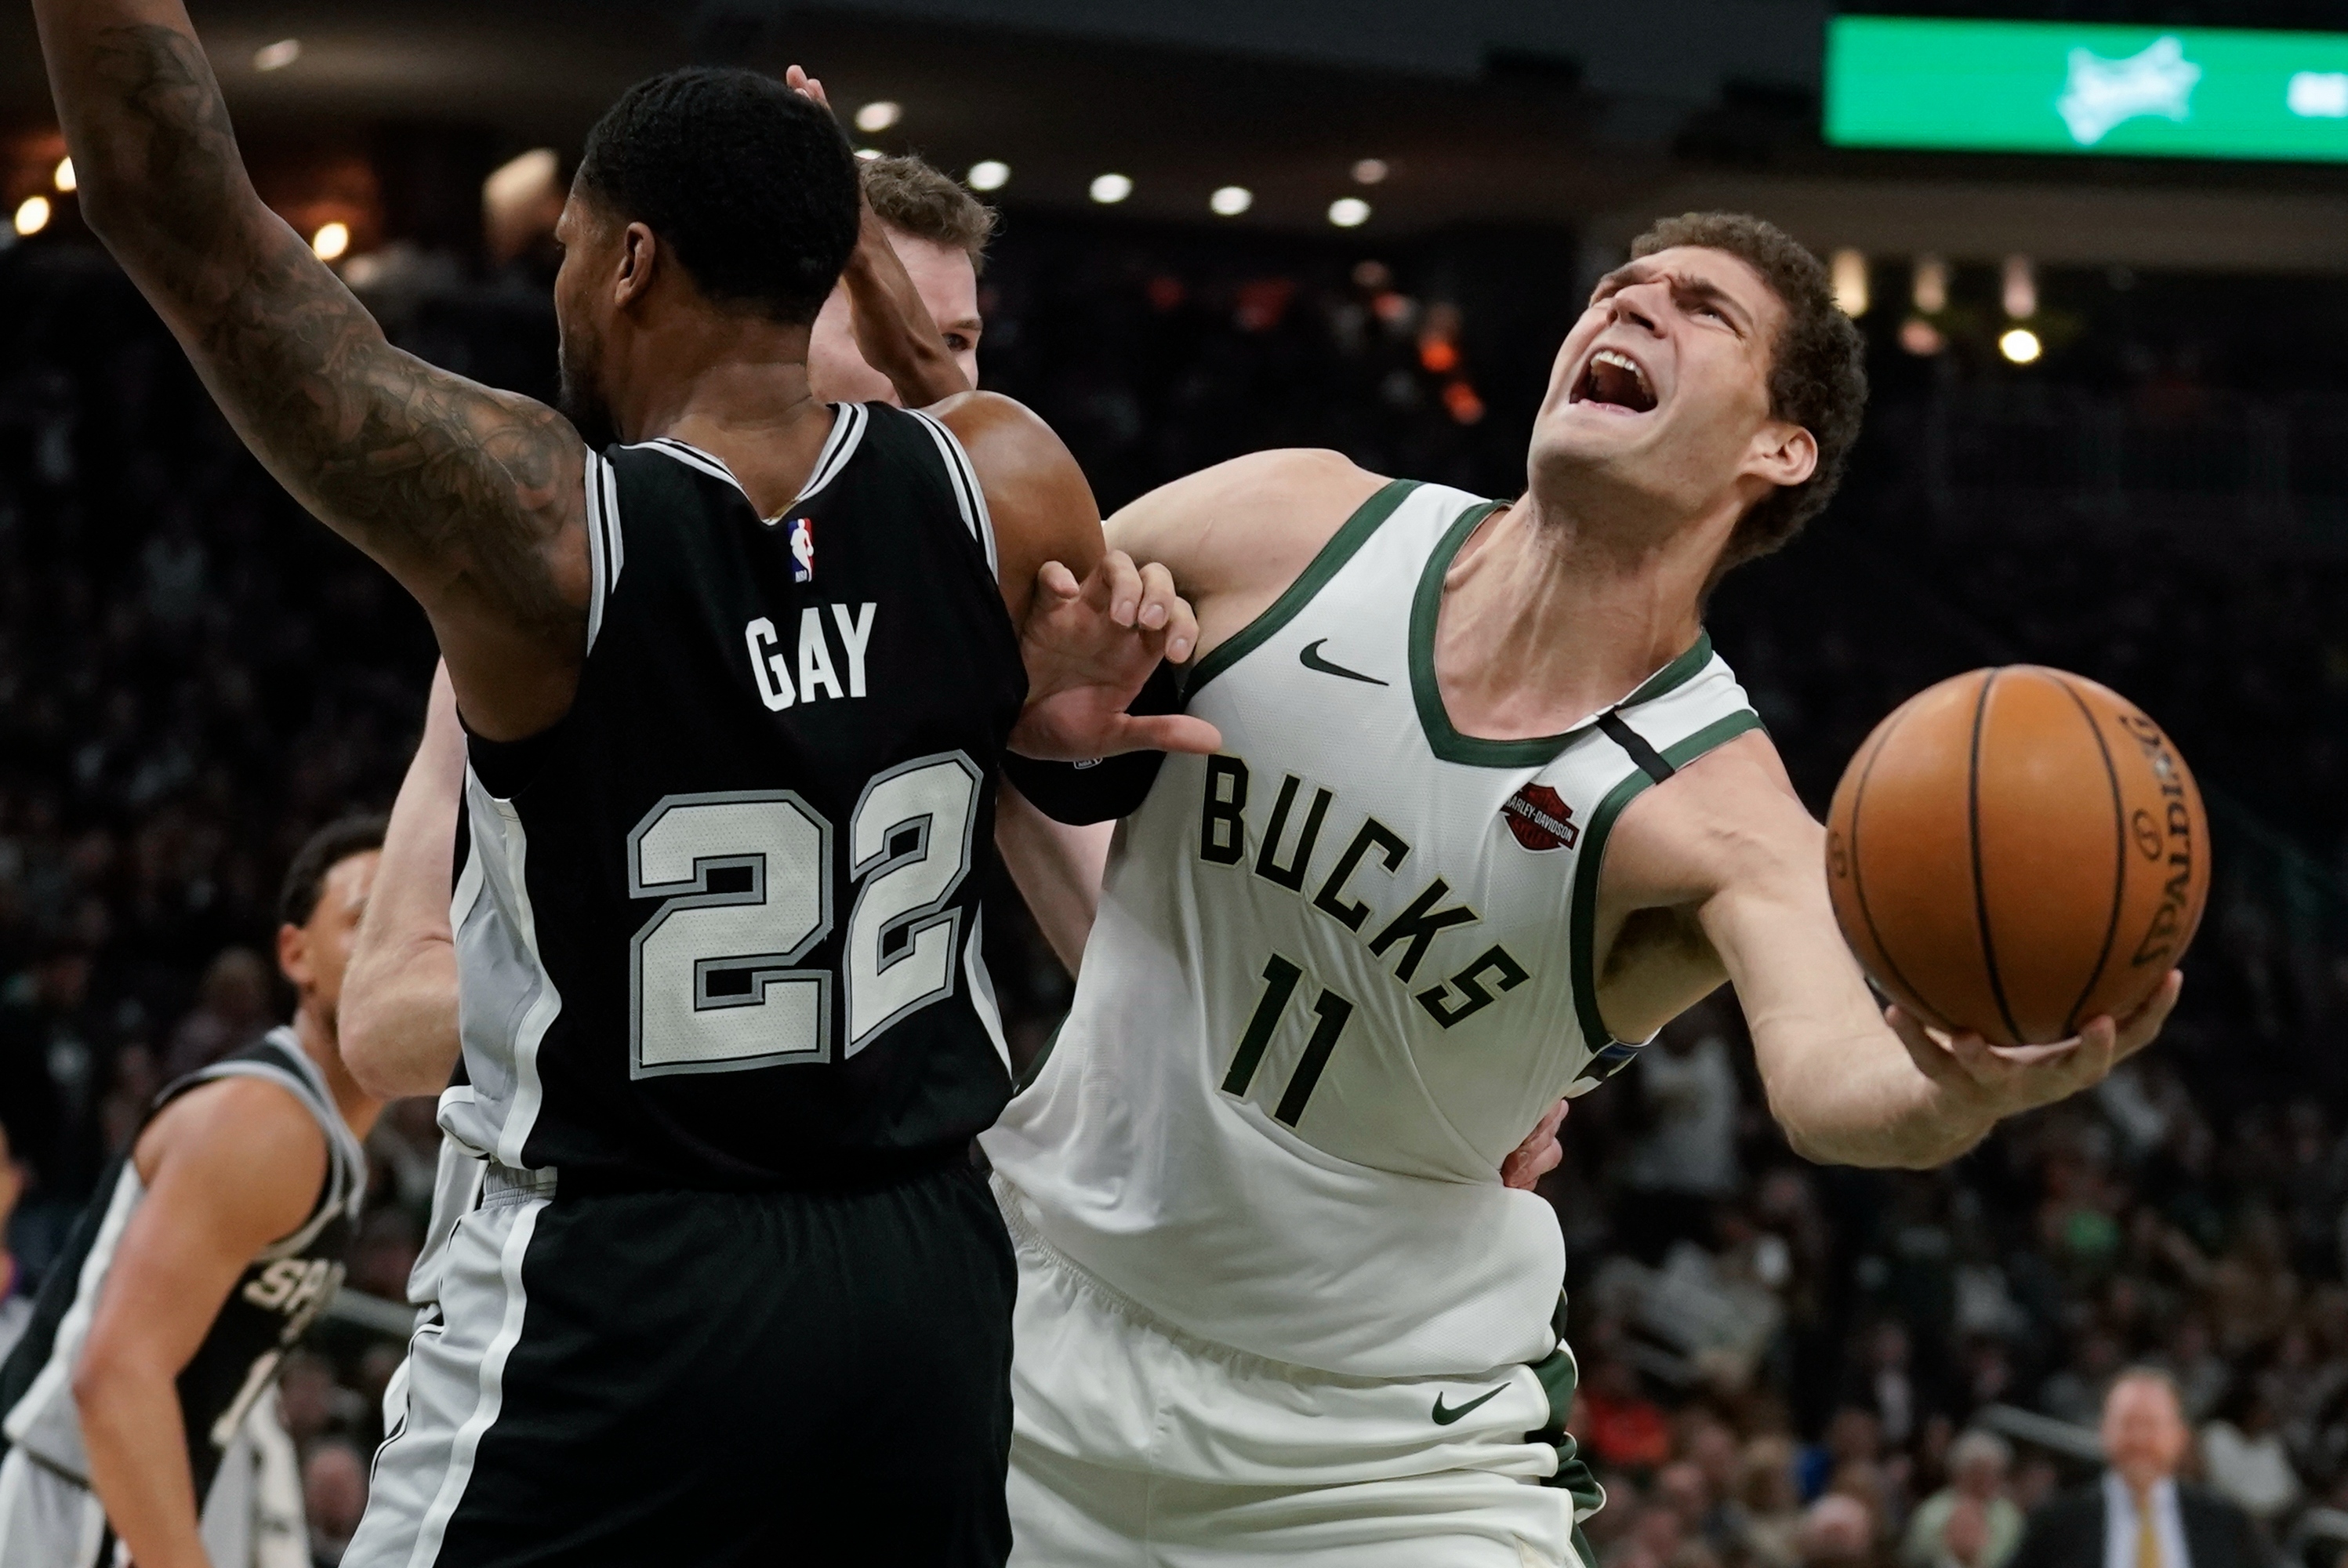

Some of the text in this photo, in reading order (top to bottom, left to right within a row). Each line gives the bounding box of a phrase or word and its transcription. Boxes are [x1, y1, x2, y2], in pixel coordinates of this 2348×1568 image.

[746, 602, 877, 712] GAY
[627, 749, 984, 1080] 22
[1199, 752, 1531, 1030] BUCKS
[1217, 949, 1358, 1131] 11
